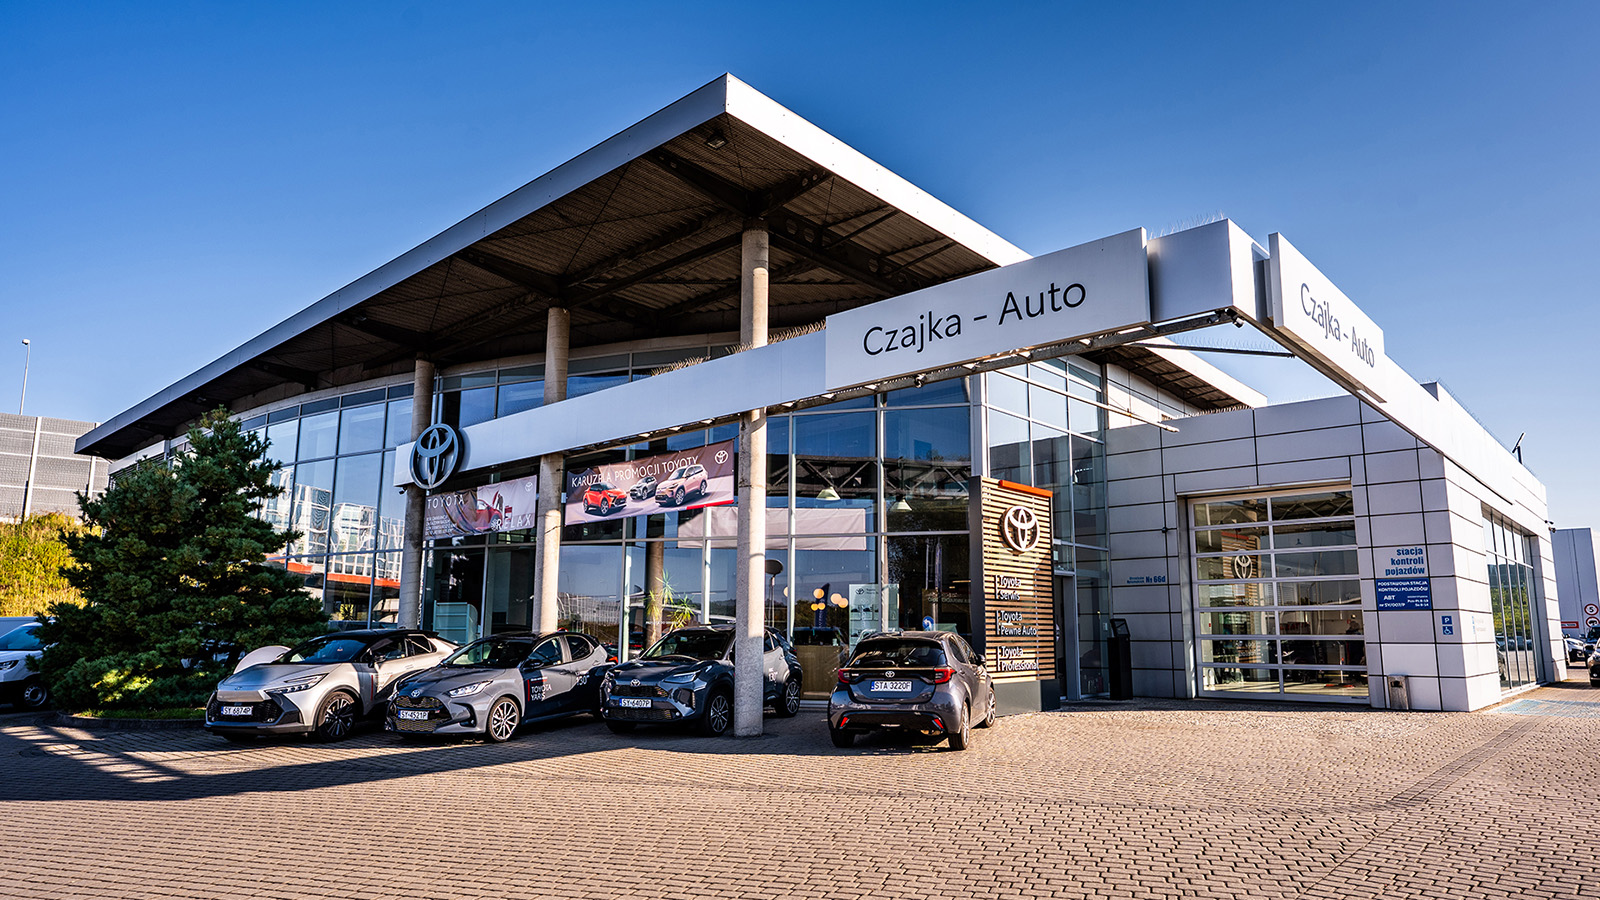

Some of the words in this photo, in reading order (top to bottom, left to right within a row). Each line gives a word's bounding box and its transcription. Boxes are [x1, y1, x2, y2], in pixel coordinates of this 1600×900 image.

[863, 310, 961, 356] Czajka
[998, 282, 1086, 326] Auto
[1300, 282, 1341, 342] Czajka
[1352, 326, 1375, 368] Auto
[614, 464, 660, 482] PROMOCJI
[661, 455, 699, 473] TOYOTY
[427, 494, 465, 510] TOYOTA
[496, 514, 532, 531] RELAX
[1396, 547, 1423, 556] stacja
[1390, 556, 1424, 566] kontroli
[1385, 566, 1425, 577] pojazdów
[999, 575, 1021, 589] Toyota
[1153, 575, 1166, 583] 66d
[999, 590, 1020, 600] Serwis
[1000, 610, 1022, 624] Toyota
[1000, 626, 1021, 636] Pewne
[1021, 626, 1037, 636] Auto
[1001, 646, 1024, 660] Toyota
[1001, 659, 1039, 672] Professional
[531, 684, 552, 694] TOYOTA
[874, 681, 888, 690] STA
